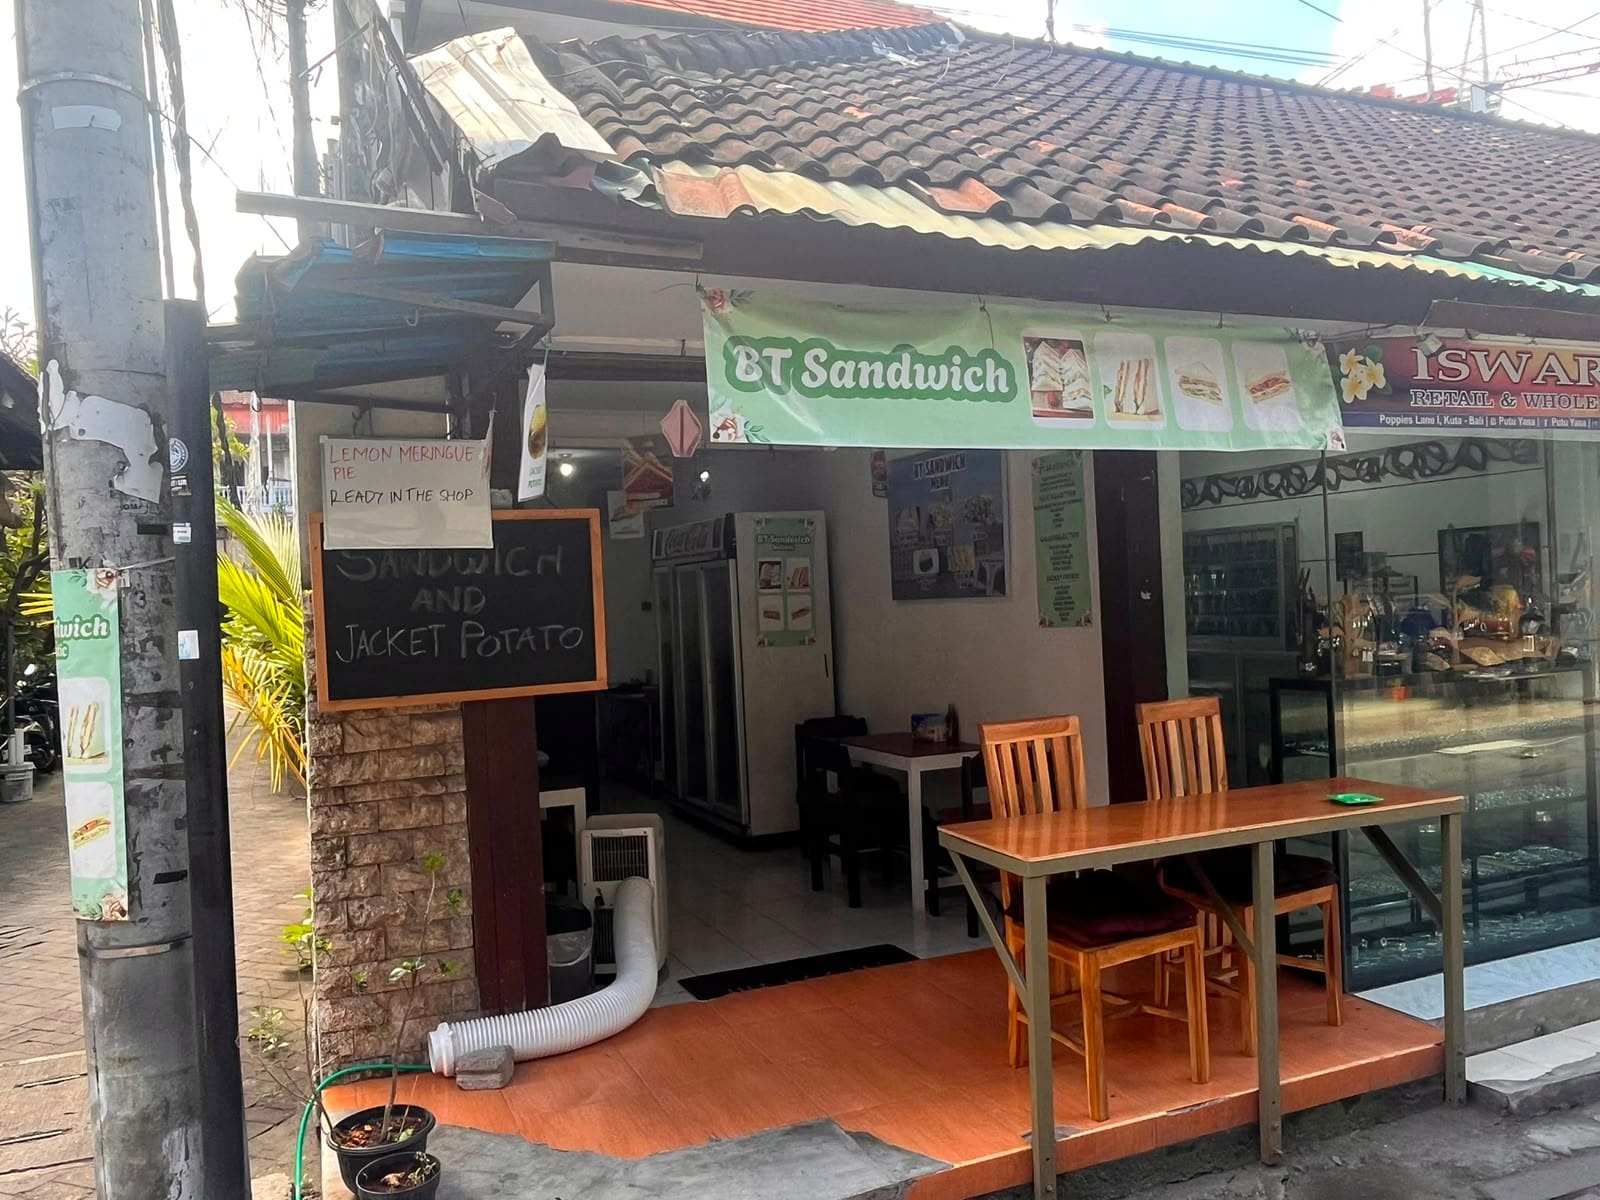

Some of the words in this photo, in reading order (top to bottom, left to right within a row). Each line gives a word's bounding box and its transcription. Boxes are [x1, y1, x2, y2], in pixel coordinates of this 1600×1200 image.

[734, 345, 792, 386] BT
[801, 348, 1009, 394] Sandwich
[1411, 348, 1600, 386] ISWAR
[1410, 388, 1494, 409] RETAIL
[1500, 391, 1518, 409] &
[1522, 392, 1600, 410] WHOLE
[1379, 414, 1414, 426] Poppies
[1443, 415, 1463, 425] Kuta
[1469, 416, 1485, 426] Bali
[329, 443, 393, 464] LEMON
[400, 444, 475, 465] MERINGUE
[333, 466, 356, 481] PIE
[390, 489, 403, 505] IN
[406, 487, 434, 503] THE
[440, 487, 476, 503] SHOP
[335, 547, 562, 581] SANDWICH
[411, 585, 486, 615] AND
[335, 623, 447, 663] JACKET
[459, 620, 584, 658] POTATO
